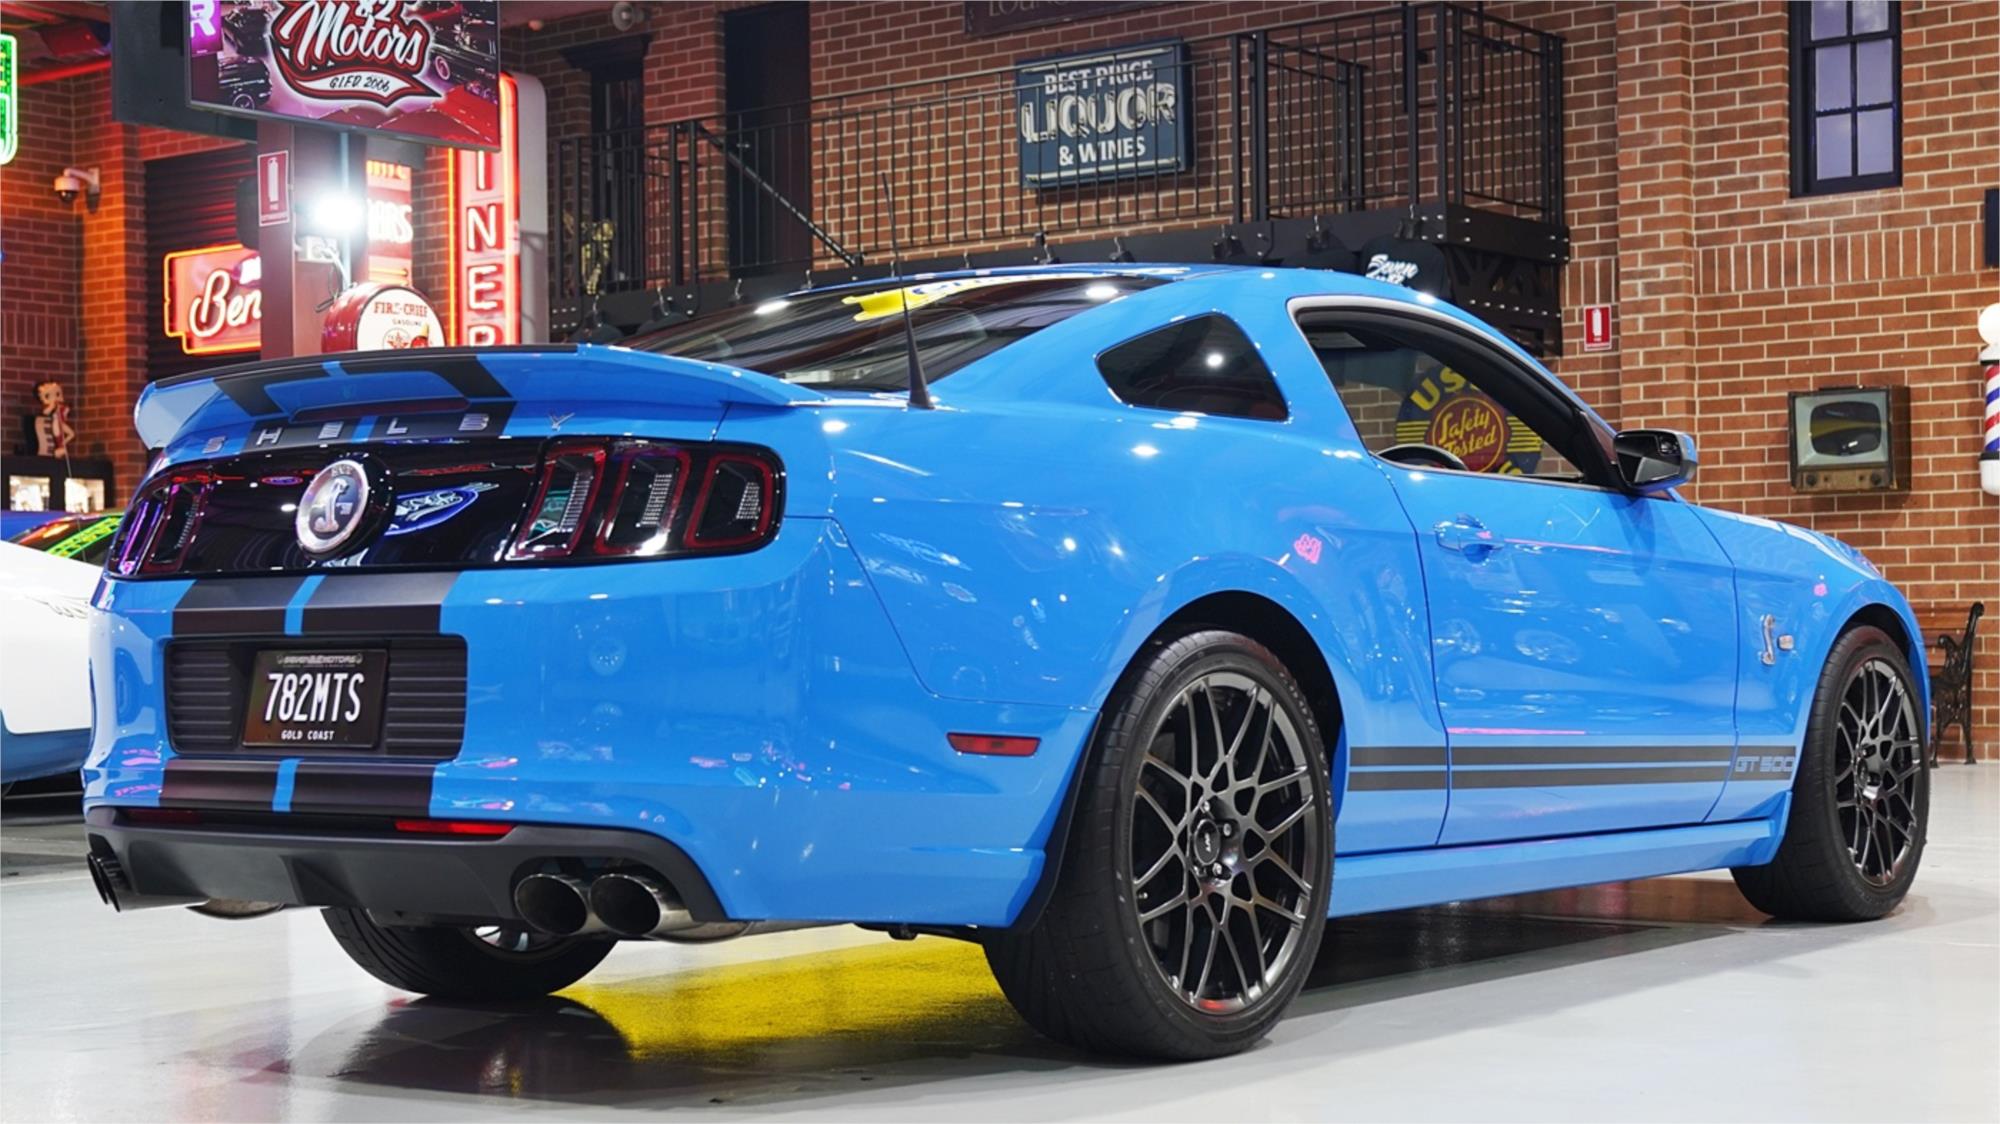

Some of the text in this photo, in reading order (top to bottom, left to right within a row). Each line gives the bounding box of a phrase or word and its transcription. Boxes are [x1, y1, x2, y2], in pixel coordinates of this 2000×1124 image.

[280, 0, 423, 66] Motors
[363, 76, 390, 92] 2006
[1045, 60, 1154, 95] BEST PRICE
[1021, 82, 1177, 143] LIQUOR
[1058, 136, 1146, 166] & WINES
[1439, 408, 1491, 445] Safety
[1444, 424, 1497, 458] Tested
[265, 672, 365, 722] 782MTS
[281, 730, 335, 740] GOLD COAST
